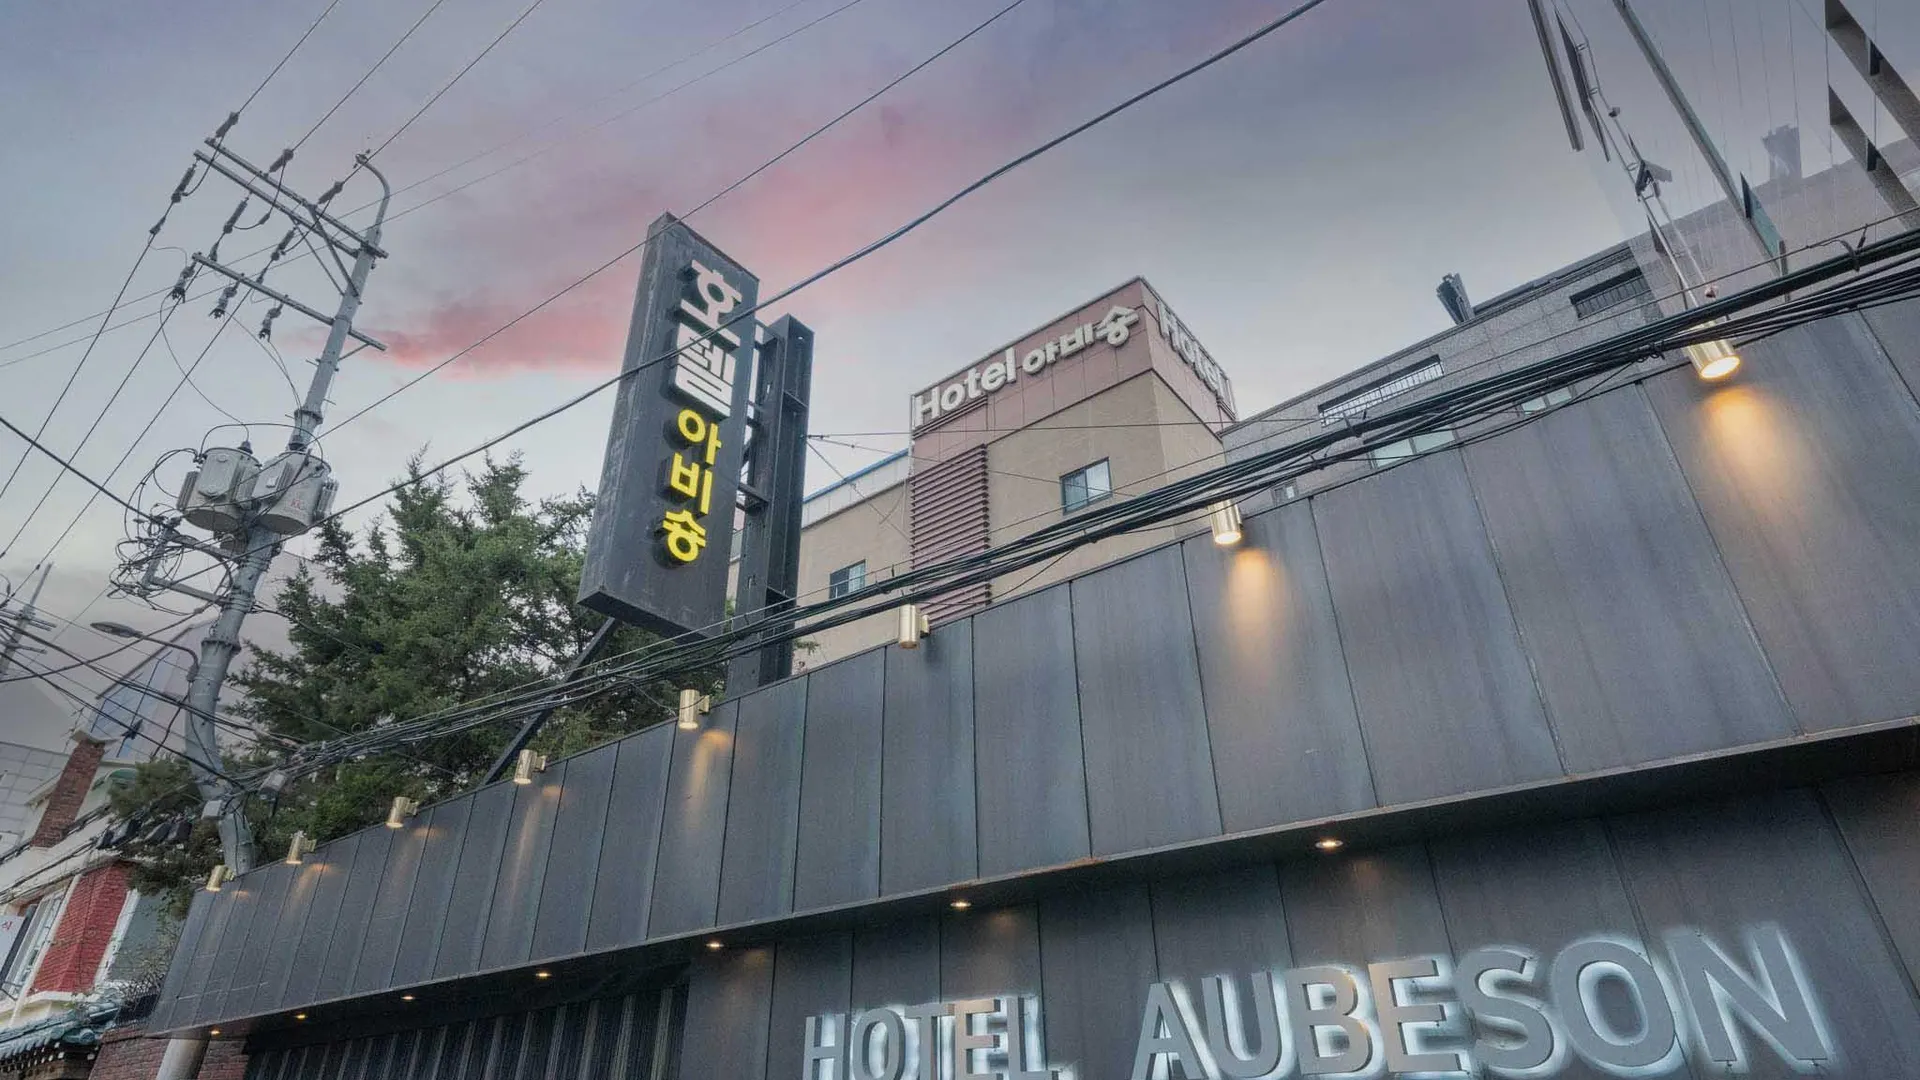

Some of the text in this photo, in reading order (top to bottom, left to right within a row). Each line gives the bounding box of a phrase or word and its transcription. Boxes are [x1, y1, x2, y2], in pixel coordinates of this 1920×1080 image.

[663, 259, 742, 562] 호텔 아비숑
[914, 306, 1140, 428] Hotel 아비숑
[802, 929, 1830, 1080] HOTEL AUBESON
